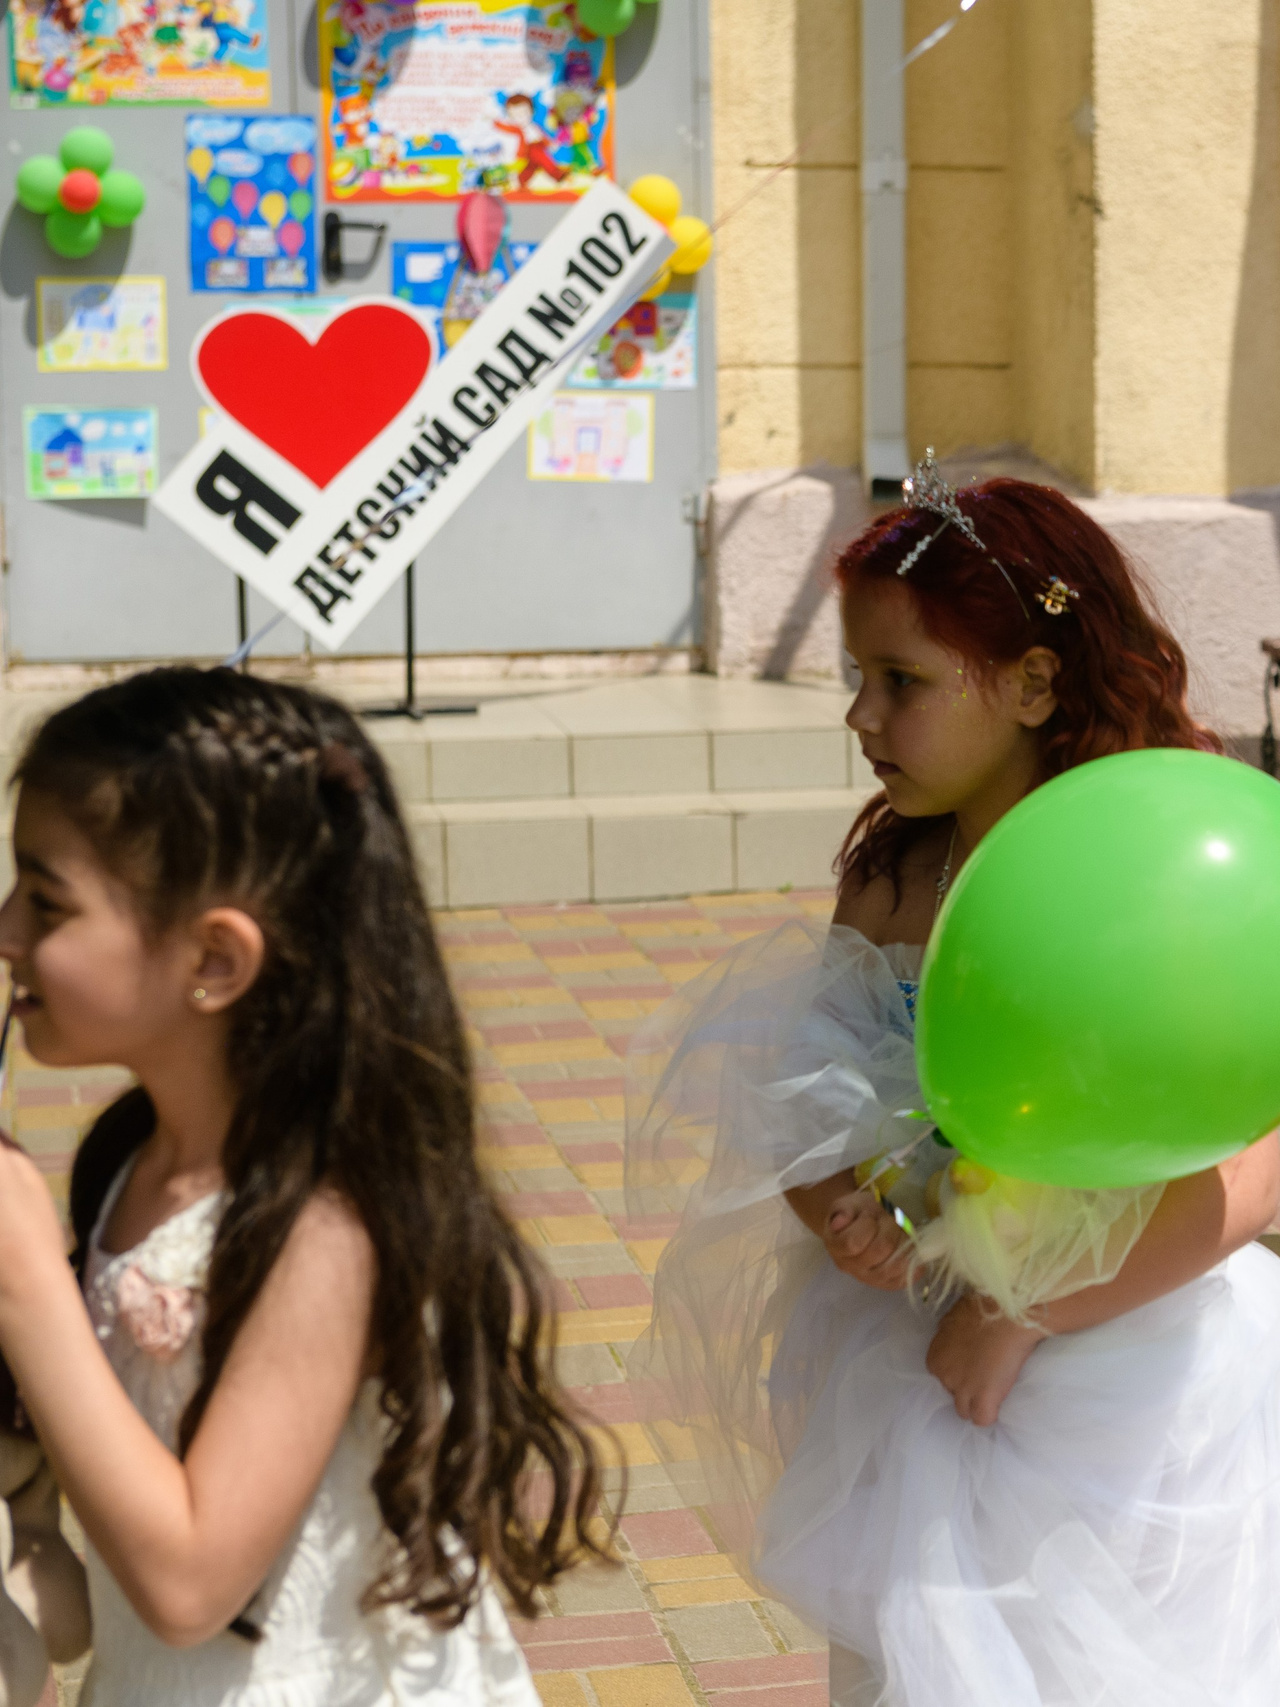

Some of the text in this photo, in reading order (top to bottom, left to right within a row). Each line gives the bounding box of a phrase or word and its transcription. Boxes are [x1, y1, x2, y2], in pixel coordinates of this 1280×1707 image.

[196, 448, 302, 556] Я
[293, 414, 471, 624] ДЕТСКИЙ
[451, 328, 554, 427] САД
